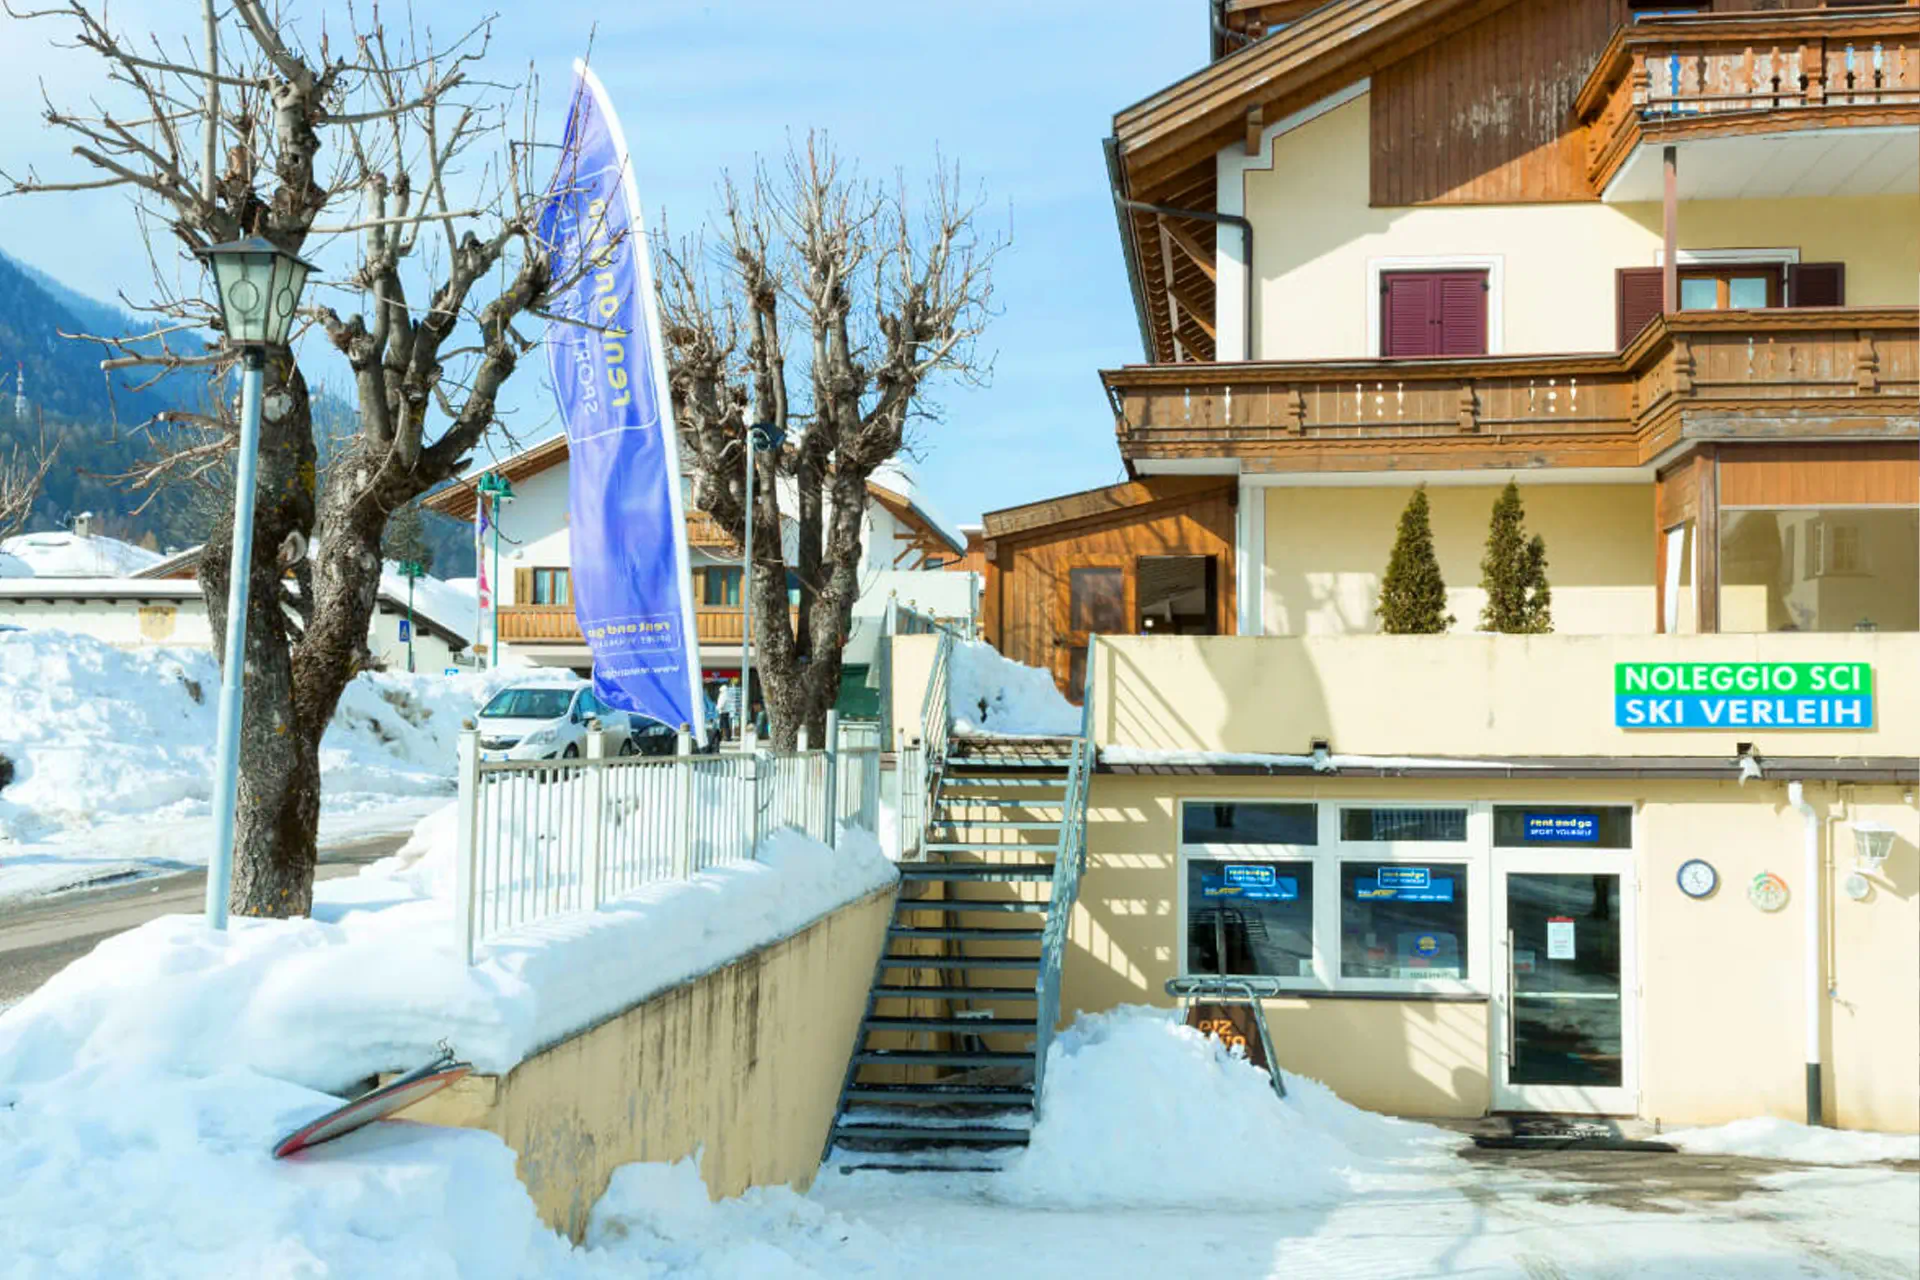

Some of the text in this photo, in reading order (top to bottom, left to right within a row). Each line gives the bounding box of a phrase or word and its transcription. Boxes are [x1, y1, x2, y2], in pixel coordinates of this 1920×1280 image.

[1625, 666, 1861, 691] NOLEGGIO SCI
[1625, 699, 1861, 724] SKI VERLEIH
[1530, 818, 1593, 830] rent and go
